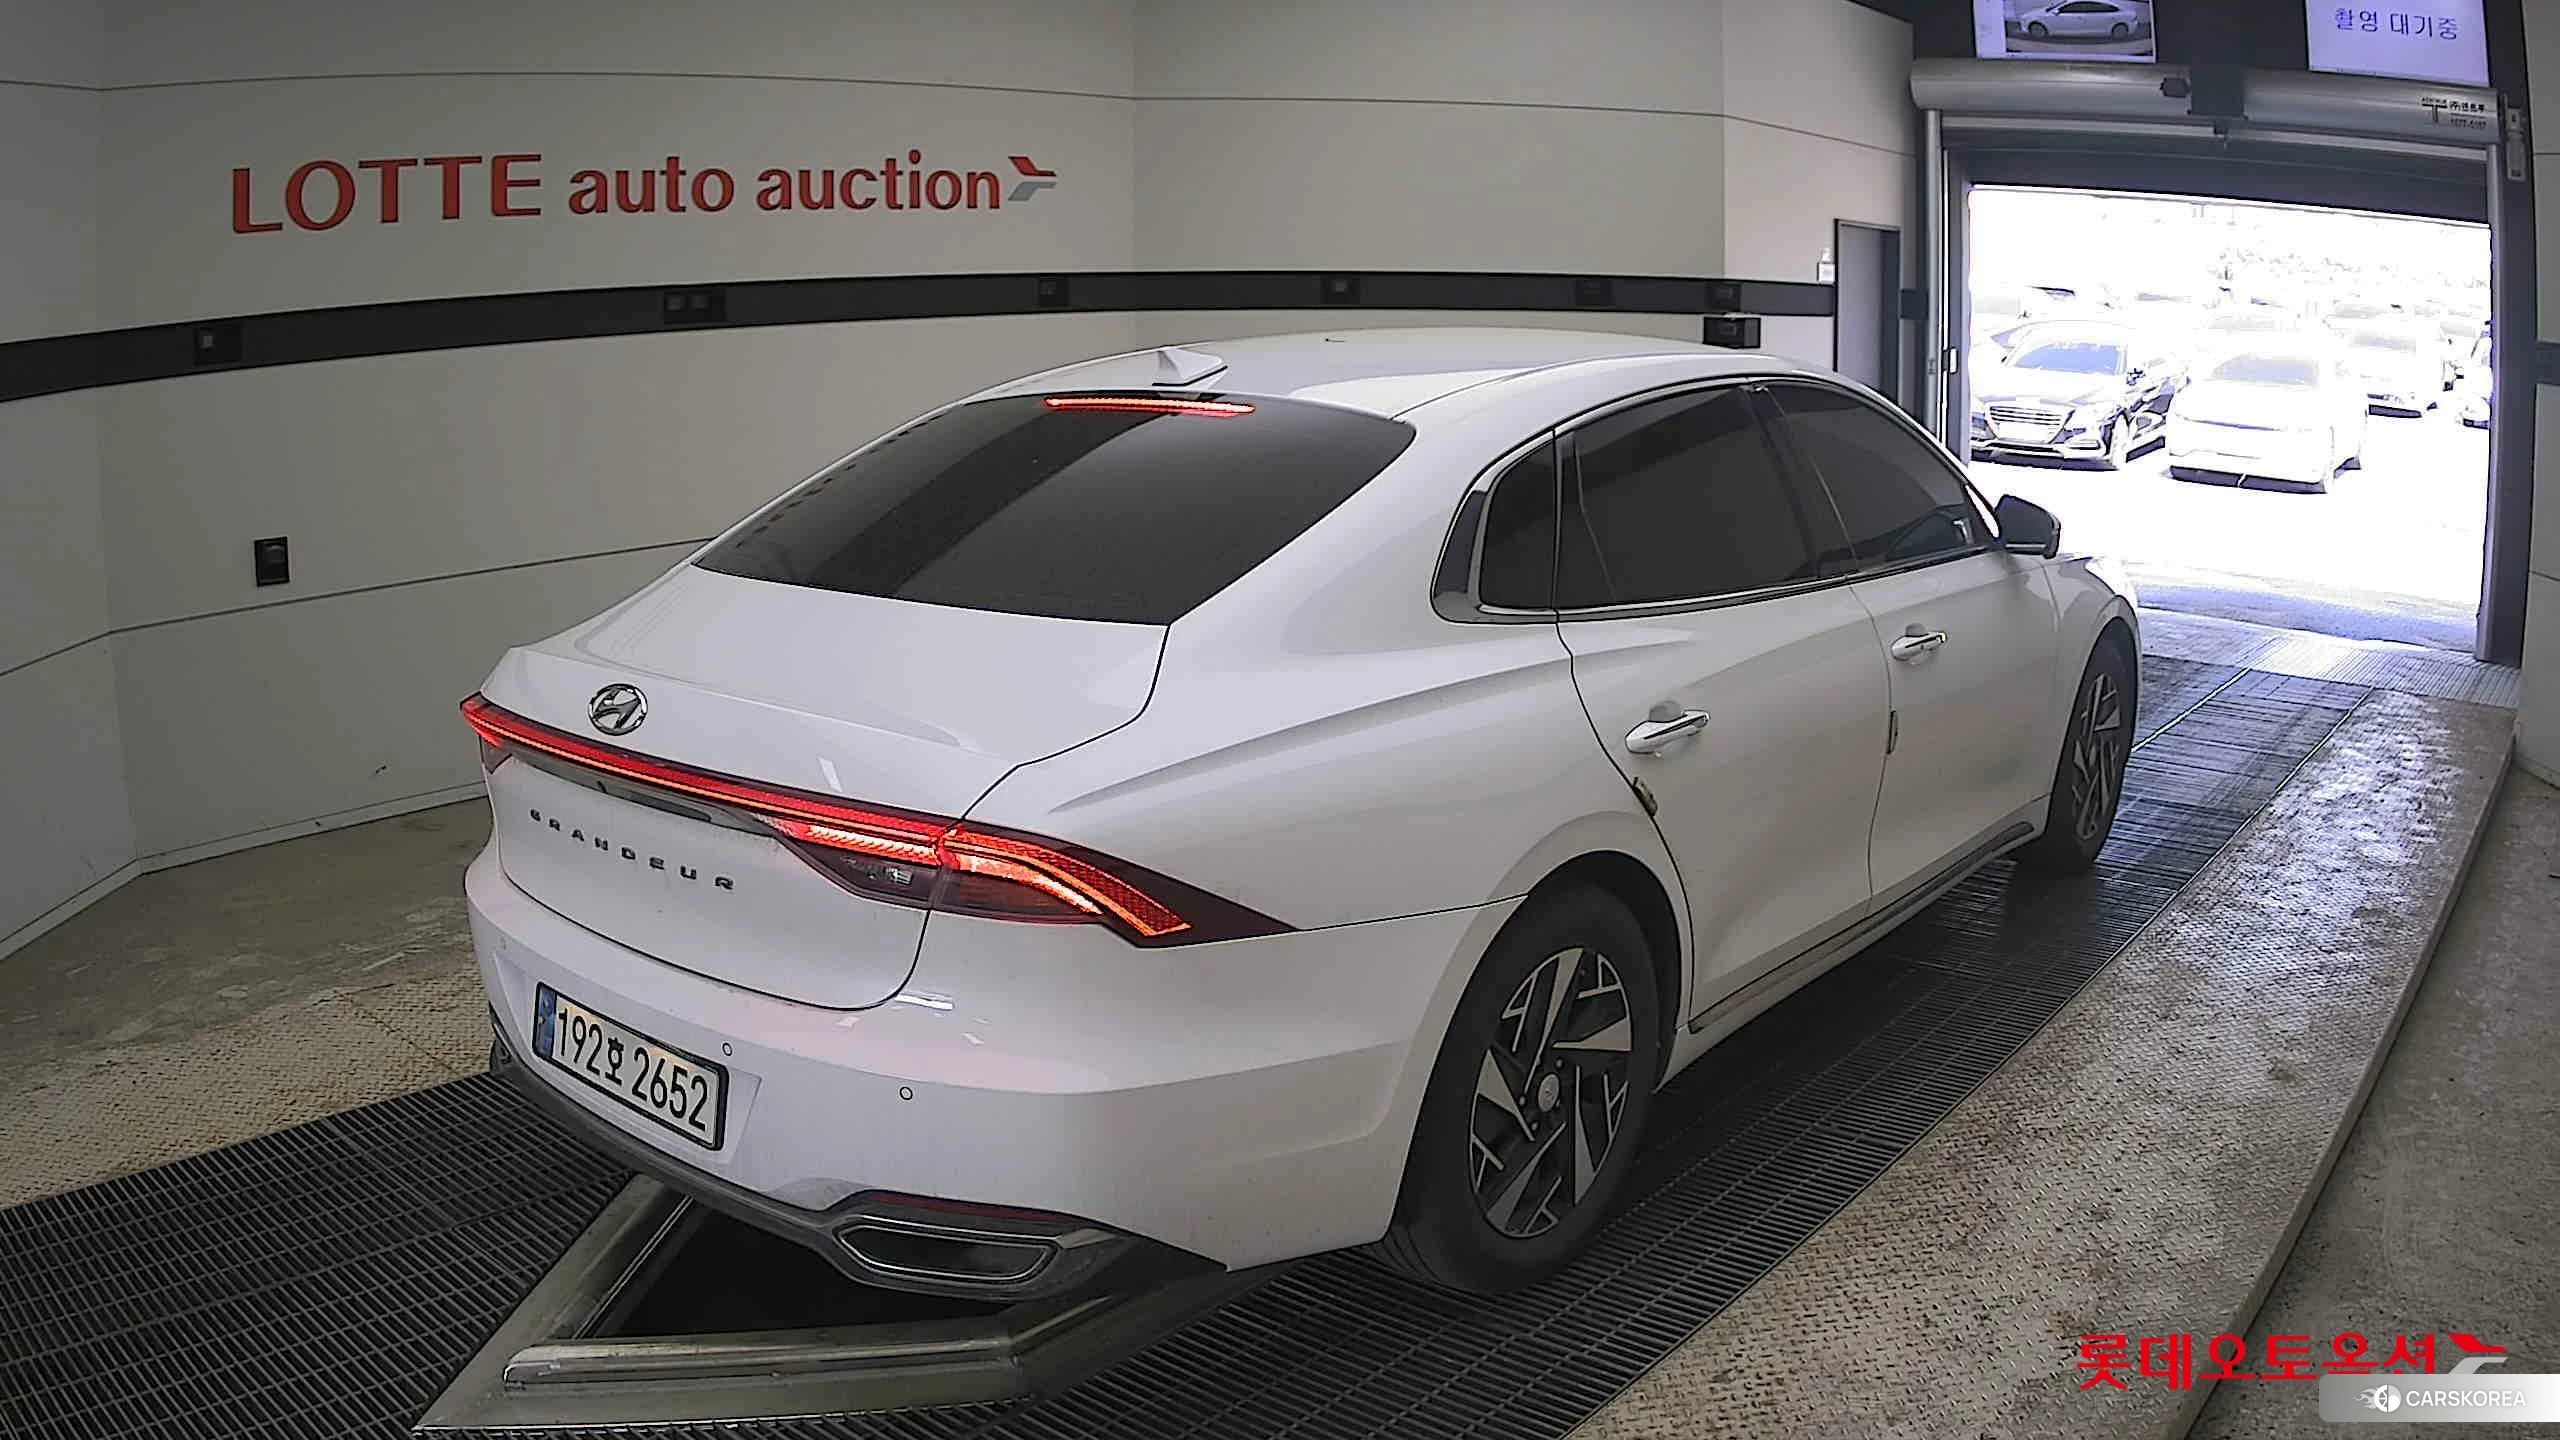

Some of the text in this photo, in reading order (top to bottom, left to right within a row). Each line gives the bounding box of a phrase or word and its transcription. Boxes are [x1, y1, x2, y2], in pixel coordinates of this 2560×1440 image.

[2335, 8, 2457, 41] 촬영 대기중
[232, 149, 1001, 234] LOTTE auto auction
[530, 808, 735, 890] GRANDEUR
[631, 1047, 708, 1132] 2652
